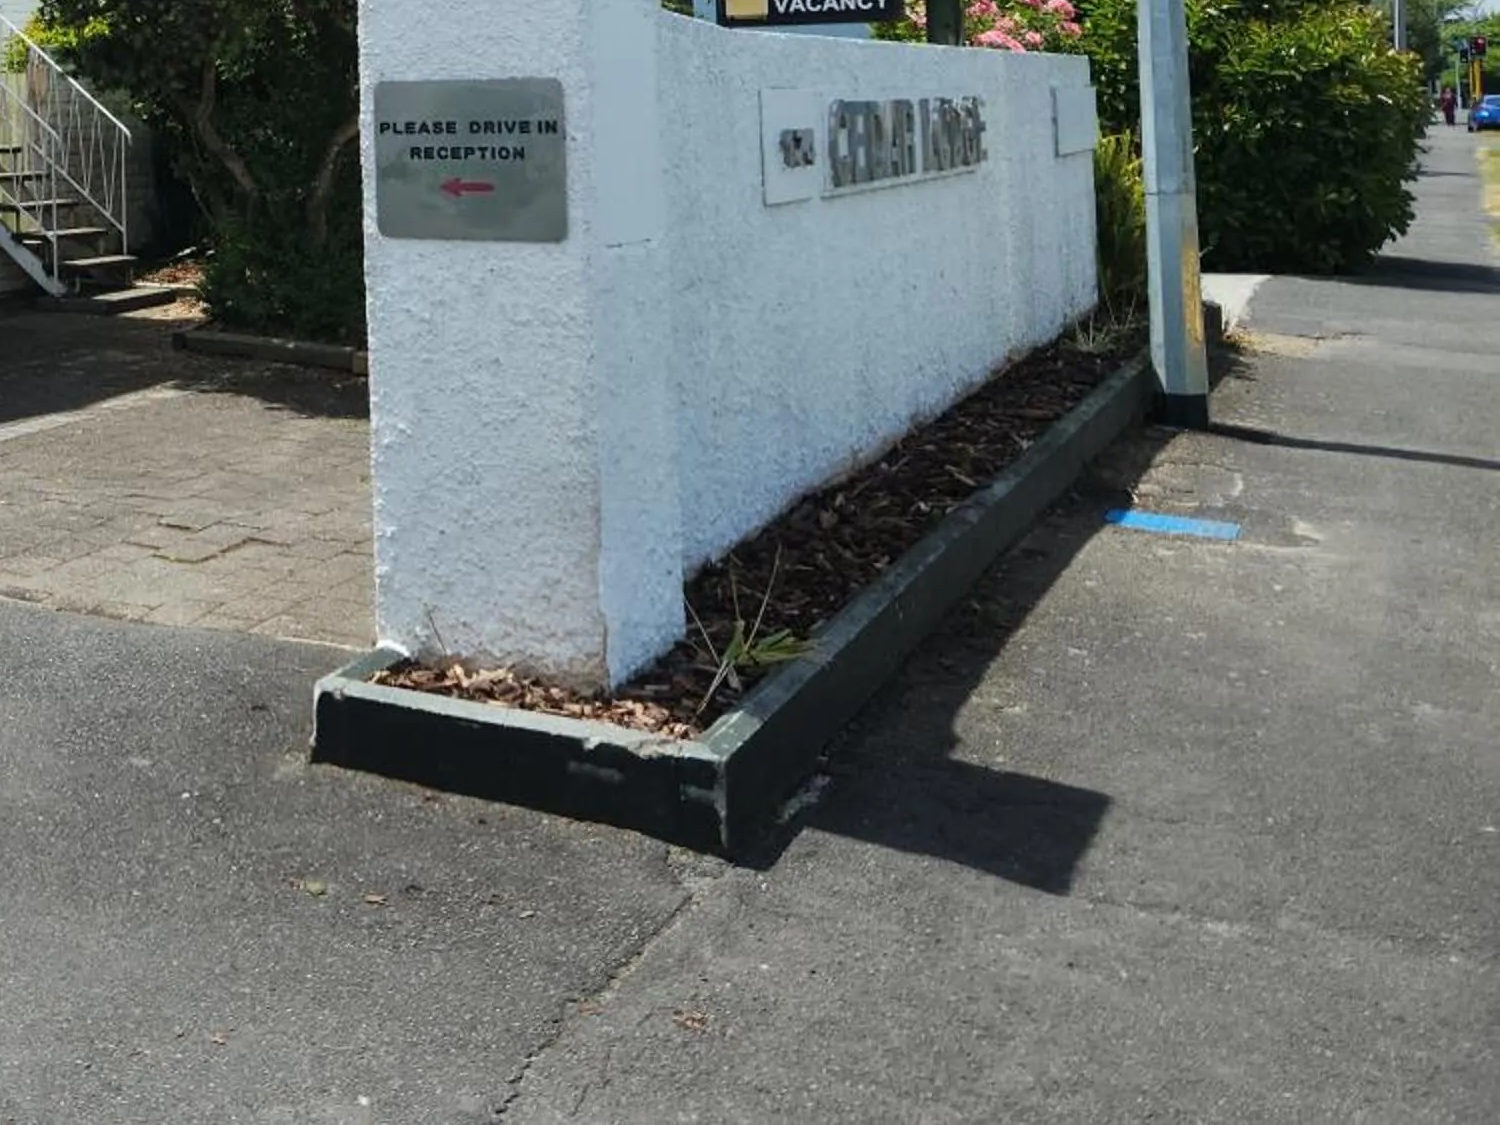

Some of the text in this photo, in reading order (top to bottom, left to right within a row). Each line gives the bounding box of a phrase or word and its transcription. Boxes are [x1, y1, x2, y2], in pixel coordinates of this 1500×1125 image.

[380, 120, 558, 135] PLEASE DRIVE IN
[410, 146, 525, 160] RECEPTION
